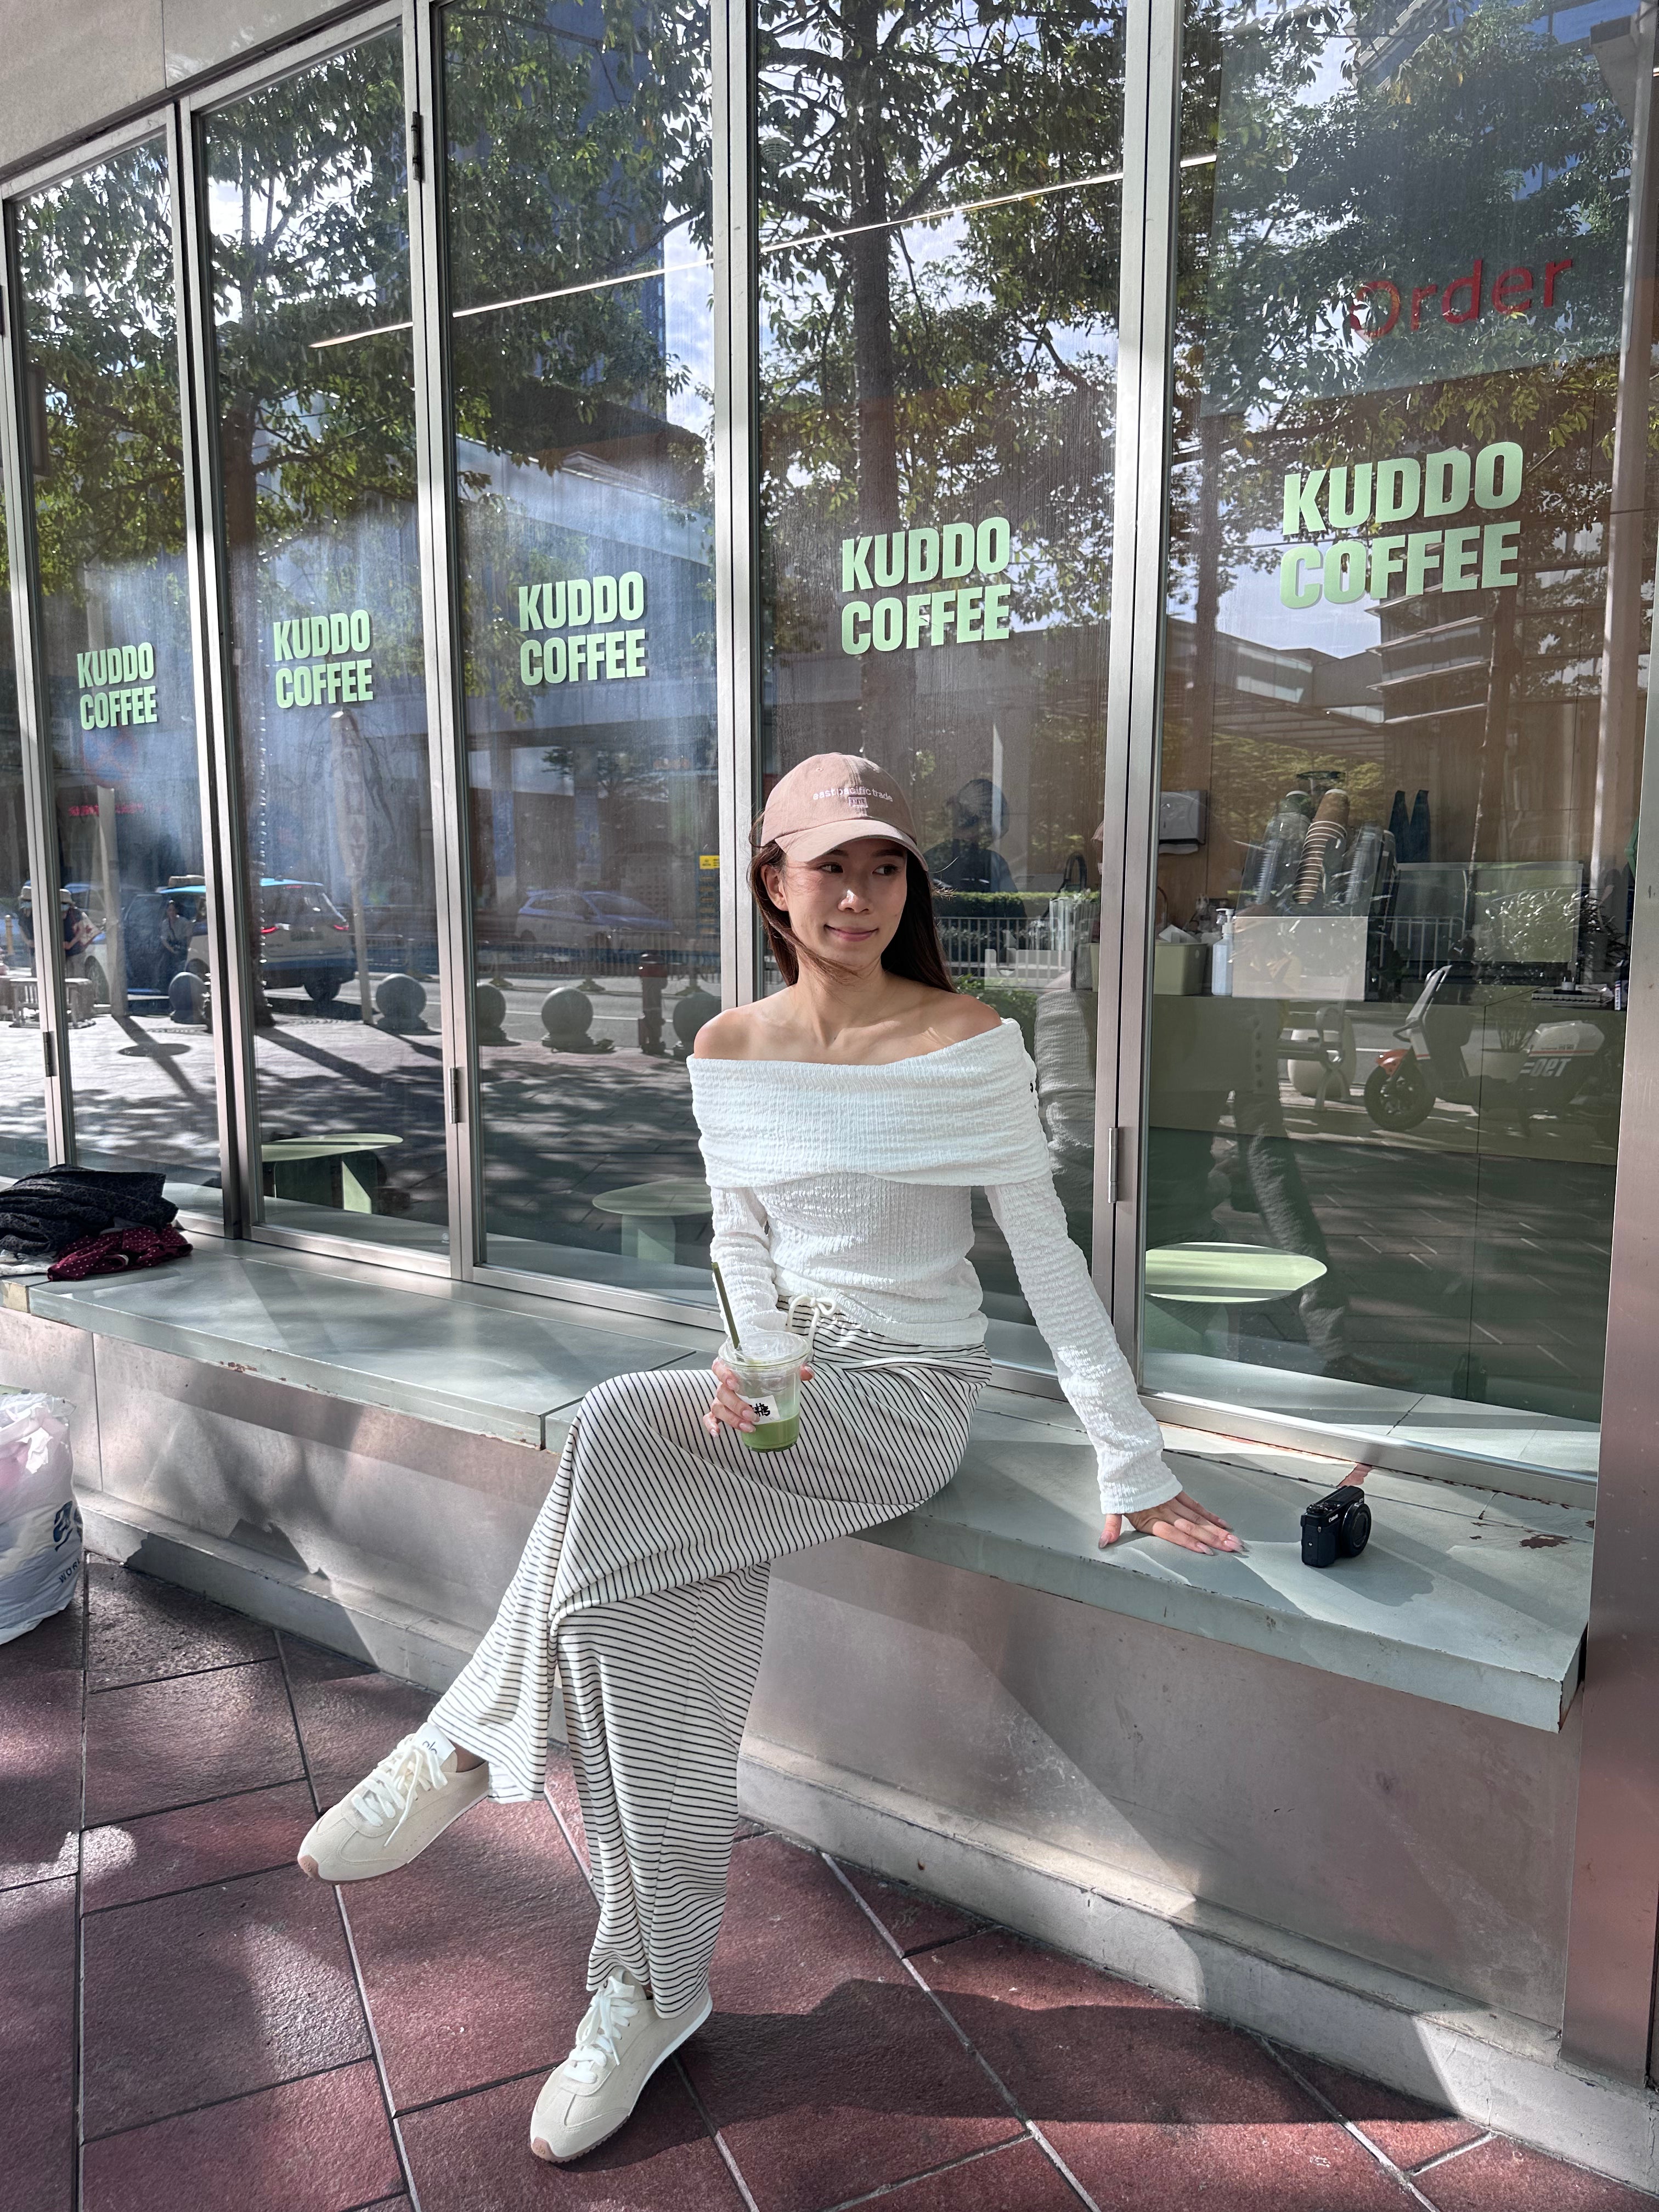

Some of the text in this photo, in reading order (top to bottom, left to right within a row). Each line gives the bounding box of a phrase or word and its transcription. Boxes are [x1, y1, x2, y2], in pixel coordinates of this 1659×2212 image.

[1348, 259, 1573, 339] Order
[1283, 442, 1523, 535] KUDDO
[842, 517, 1011, 592] KUDDO
[1280, 521, 1520, 609] COFFEE
[519, 571, 645, 631] KUDDO
[842, 584, 1011, 655] COFFEE
[273, 610, 371, 662] KUDDO
[520, 629, 646, 686] COFFEE
[77, 642, 155, 689] KUDDO
[276, 659, 374, 708] COFFEE
[80, 685, 157, 730] COFFEE
[812, 786, 893, 802] east pacific trade
